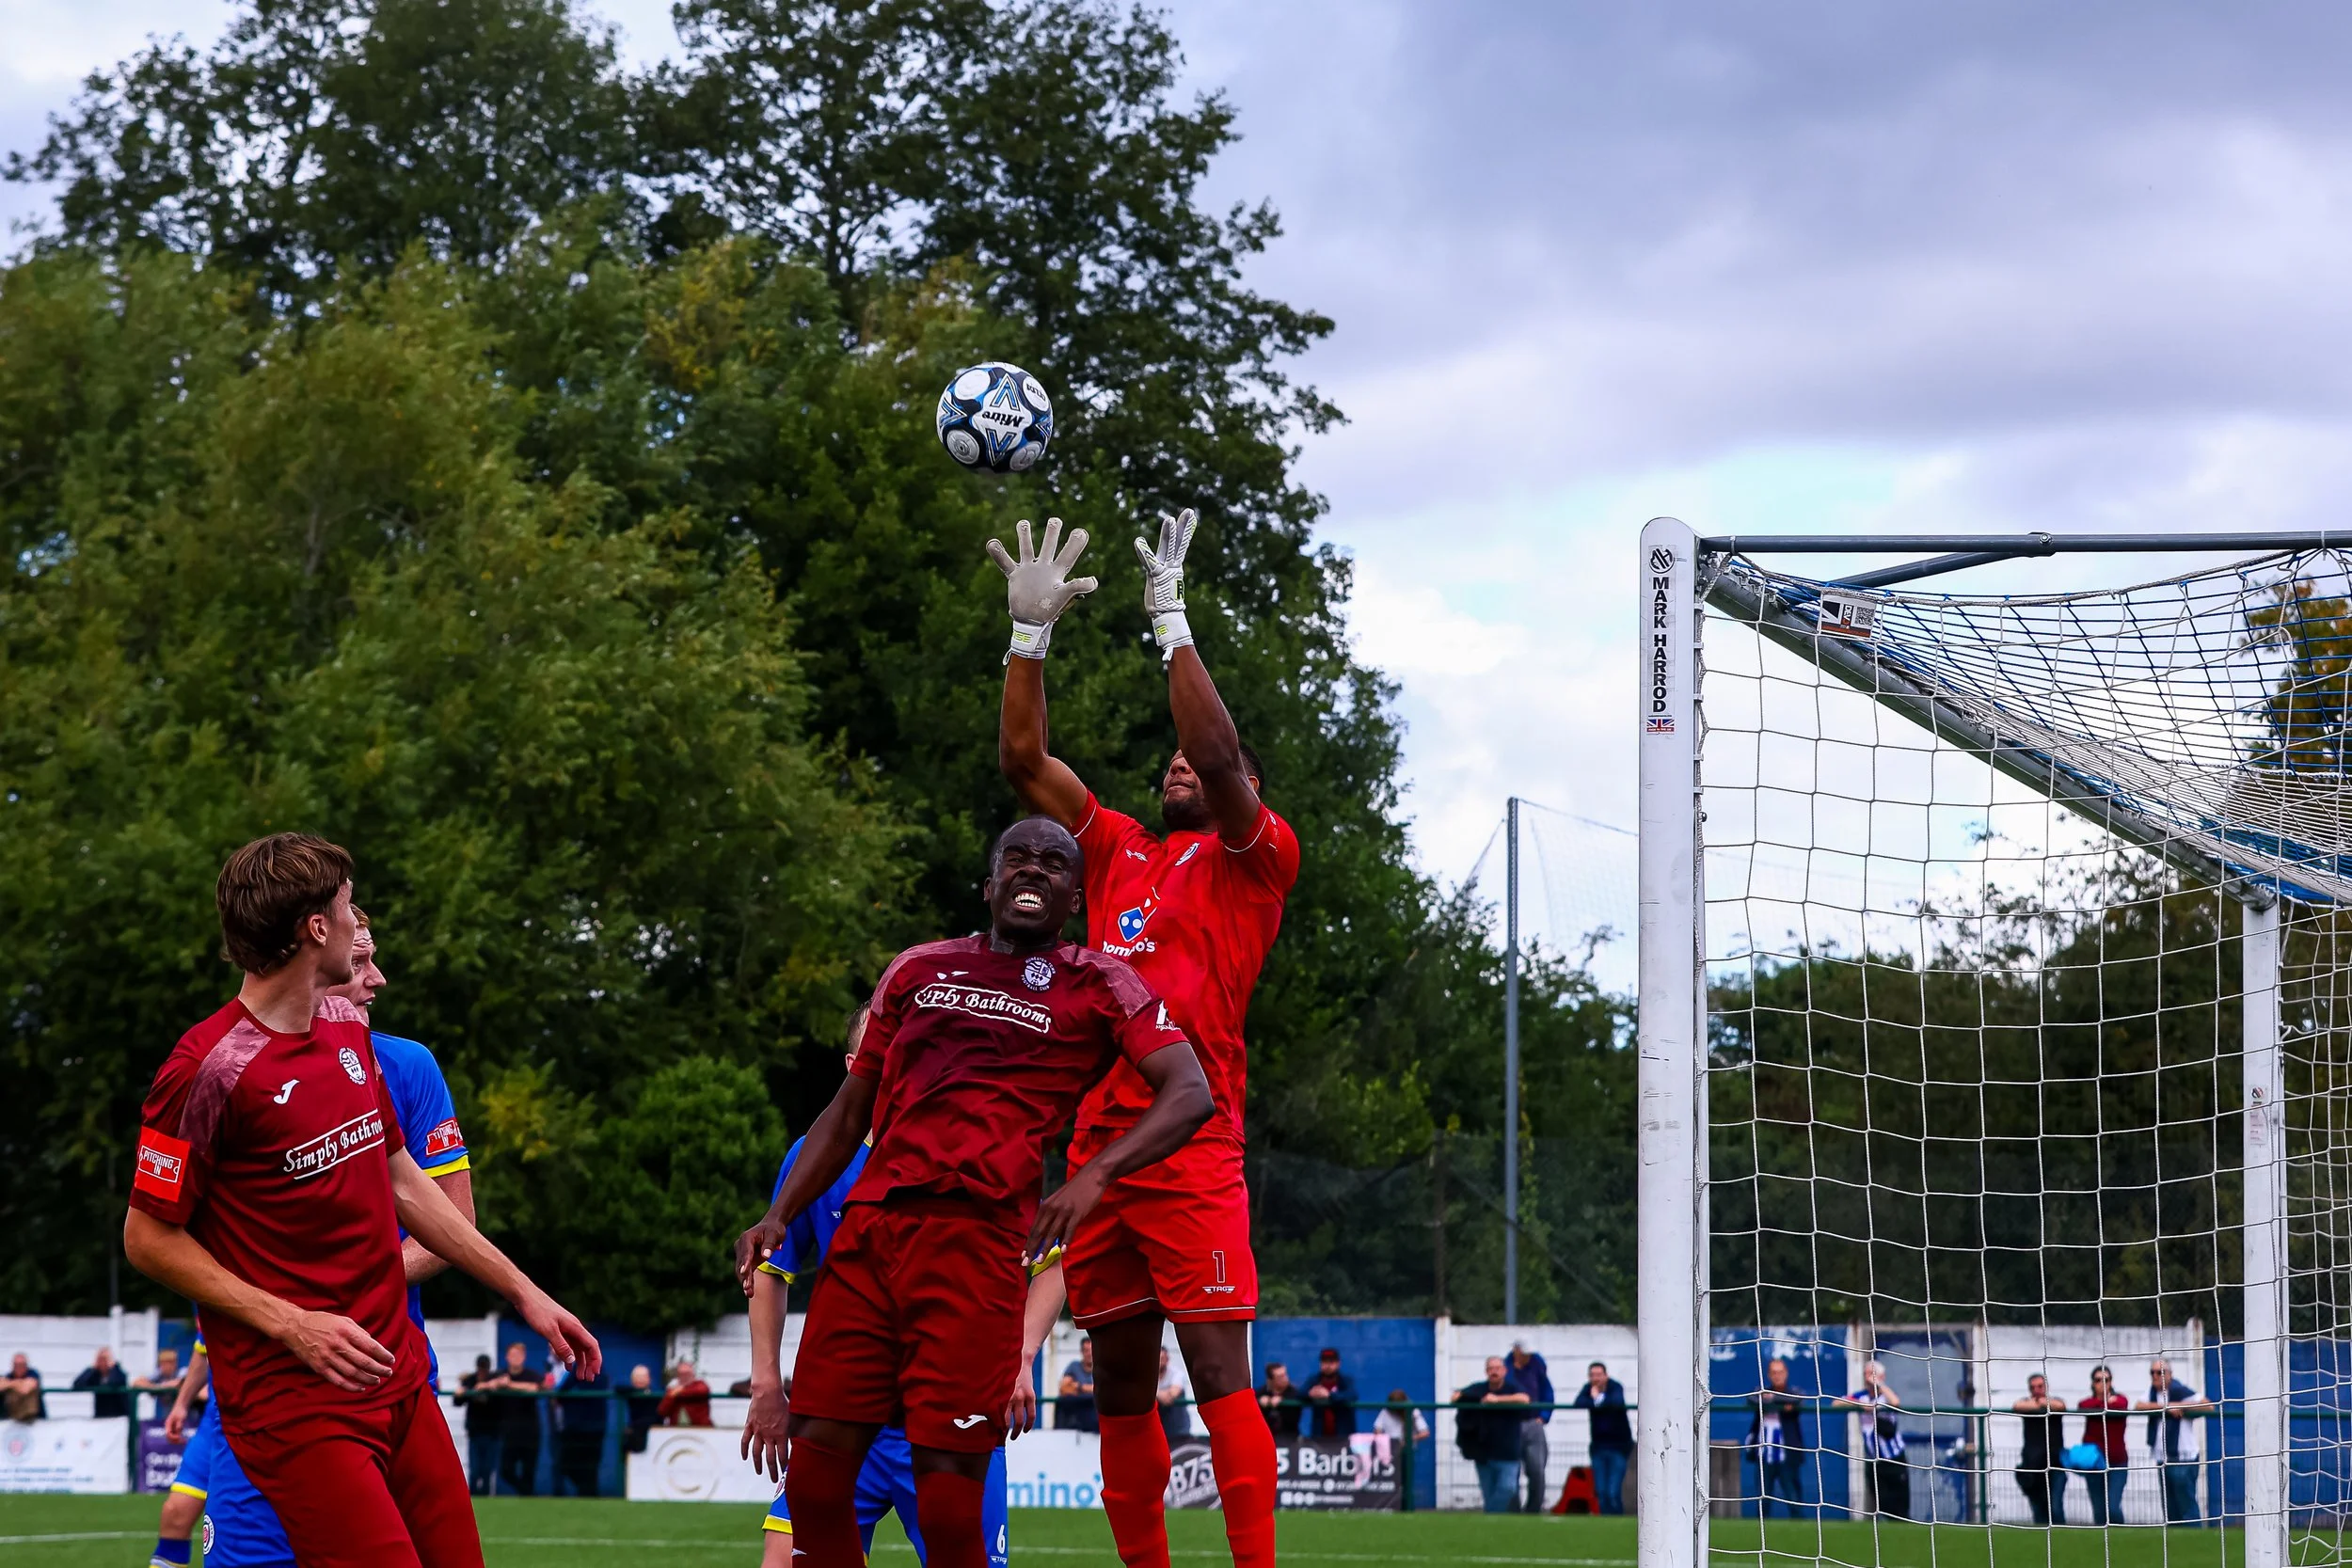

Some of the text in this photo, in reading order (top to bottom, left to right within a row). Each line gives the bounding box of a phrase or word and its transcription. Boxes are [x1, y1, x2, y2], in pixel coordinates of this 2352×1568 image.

[981, 411, 1025, 428] Mitre
[1653, 577, 1669, 628] MARK
[1653, 634, 1667, 713] HARROD
[965, 993, 1052, 1034] Bathrooms
[143, 1149, 174, 1169] PITCHING
[153, 1165, 162, 1176] IN
[283, 1136, 338, 1173] Simply
[1212, 1250, 1226, 1284] 1
[996, 1524, 1006, 1554] 6
